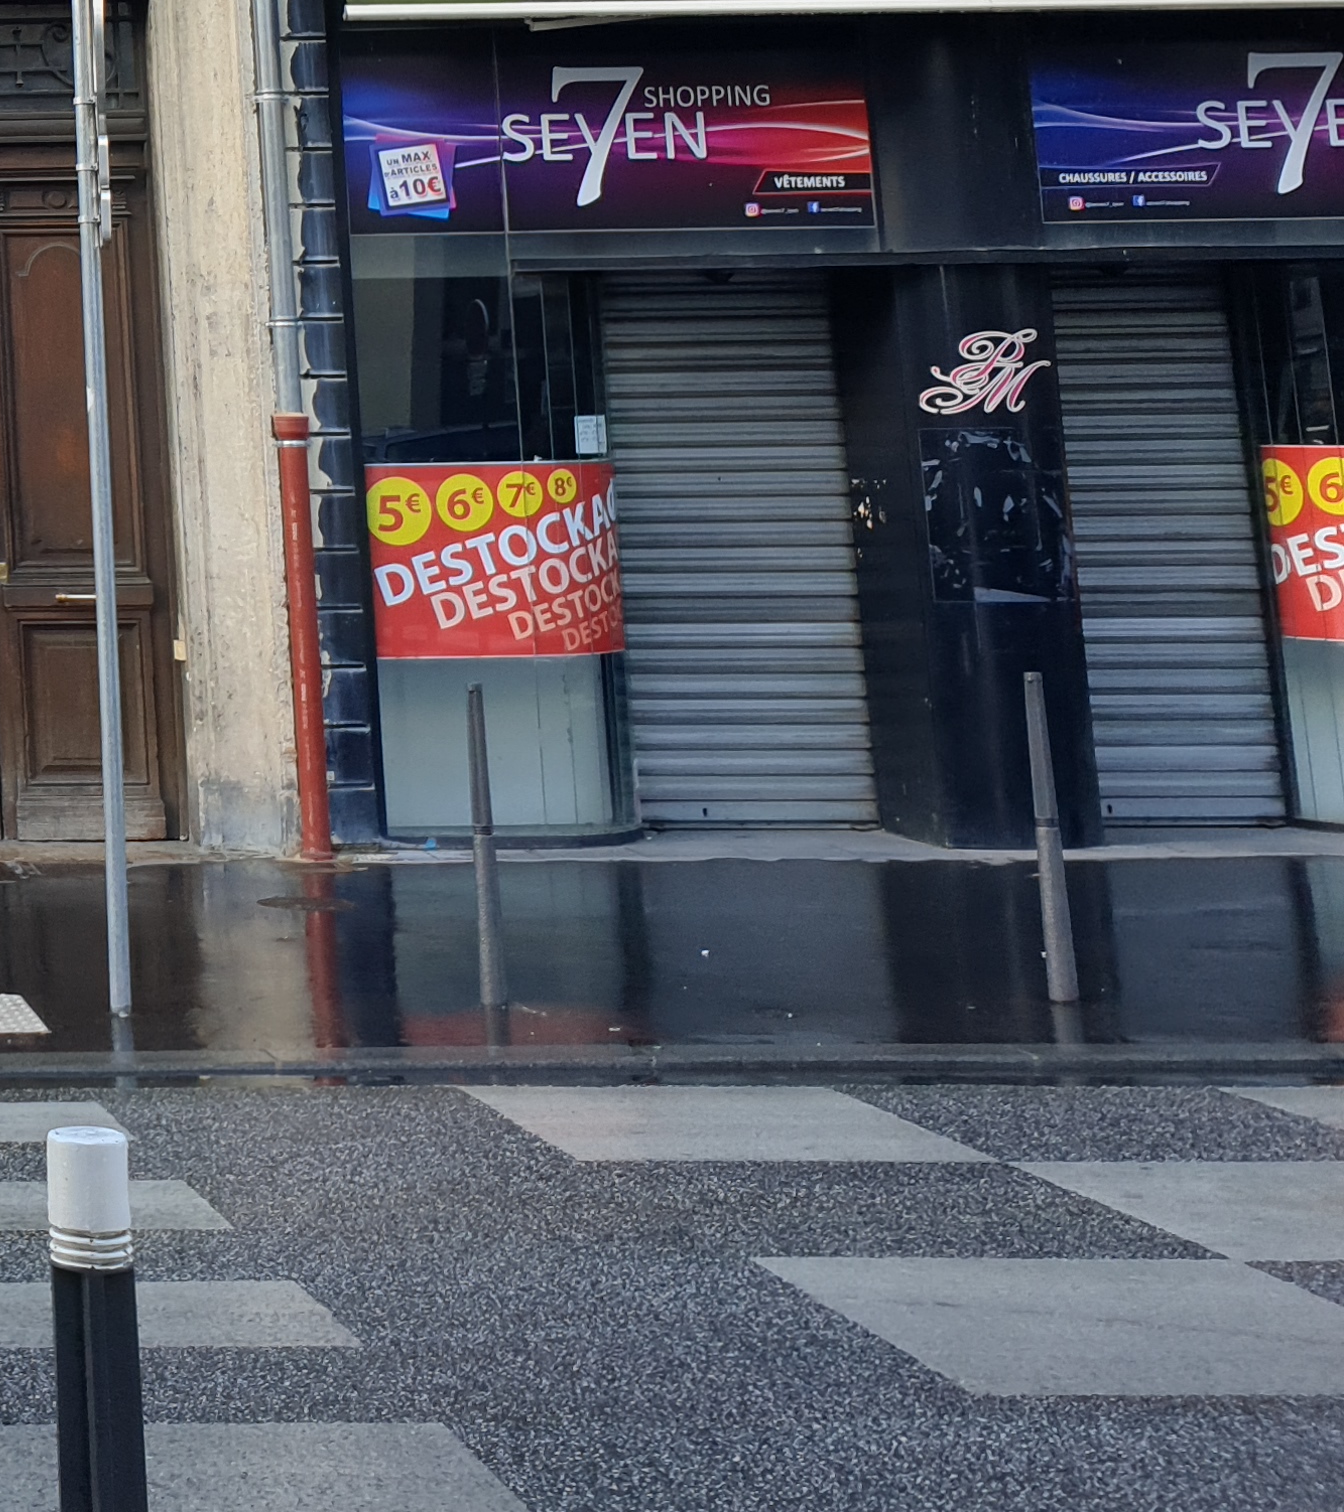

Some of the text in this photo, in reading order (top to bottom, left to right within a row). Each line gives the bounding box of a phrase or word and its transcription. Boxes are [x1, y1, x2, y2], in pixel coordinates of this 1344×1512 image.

[643, 85, 771, 108] SHOPPING
[386, 150, 431, 167] UN MAX
[774, 174, 845, 188] VÊTEMENTS
[1059, 172, 1127, 183] CHAUSSURES
[1137, 171, 1207, 182] ACCESSOIRES
[446, 487, 484, 521] 6€
[505, 482, 536, 508] 7€
[378, 493, 421, 532] 5€
[1271, 523, 1344, 585] DES
